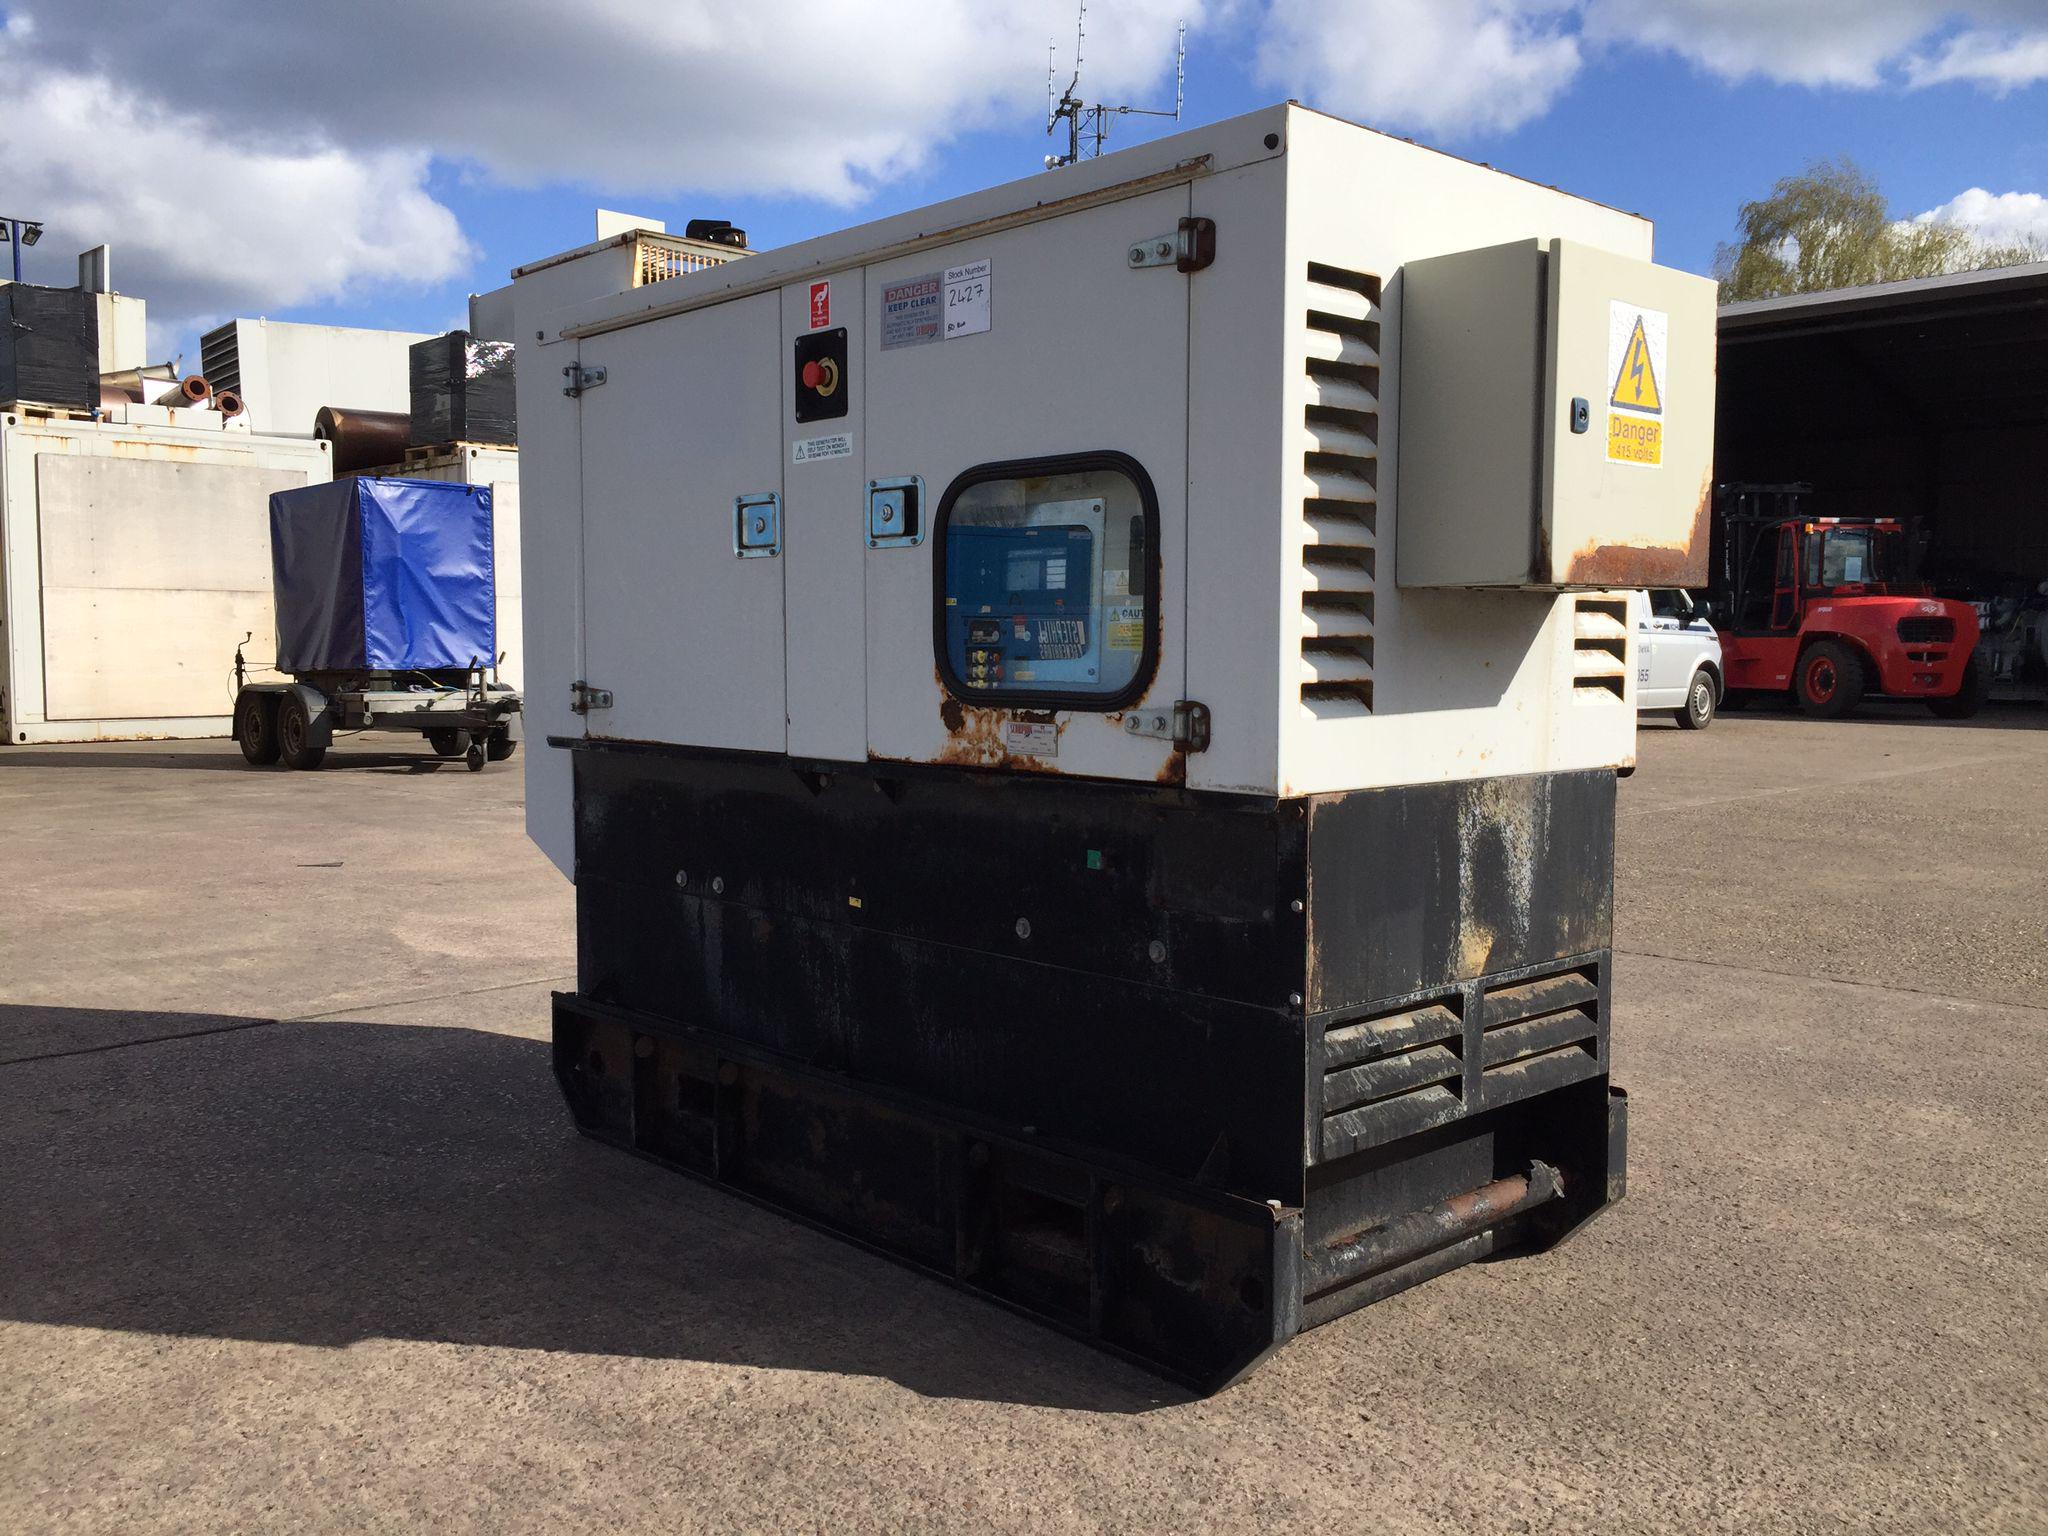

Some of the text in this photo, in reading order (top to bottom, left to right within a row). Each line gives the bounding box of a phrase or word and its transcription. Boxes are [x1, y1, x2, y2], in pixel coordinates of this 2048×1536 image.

[948, 264, 987, 280] Stock Number
[888, 283, 937, 300] DANGER
[949, 283, 984, 307] 2427
[887, 295, 937, 313] KEEP CLEAR
[1613, 416, 1659, 446] Danger
[1616, 444, 1632, 458] 415
